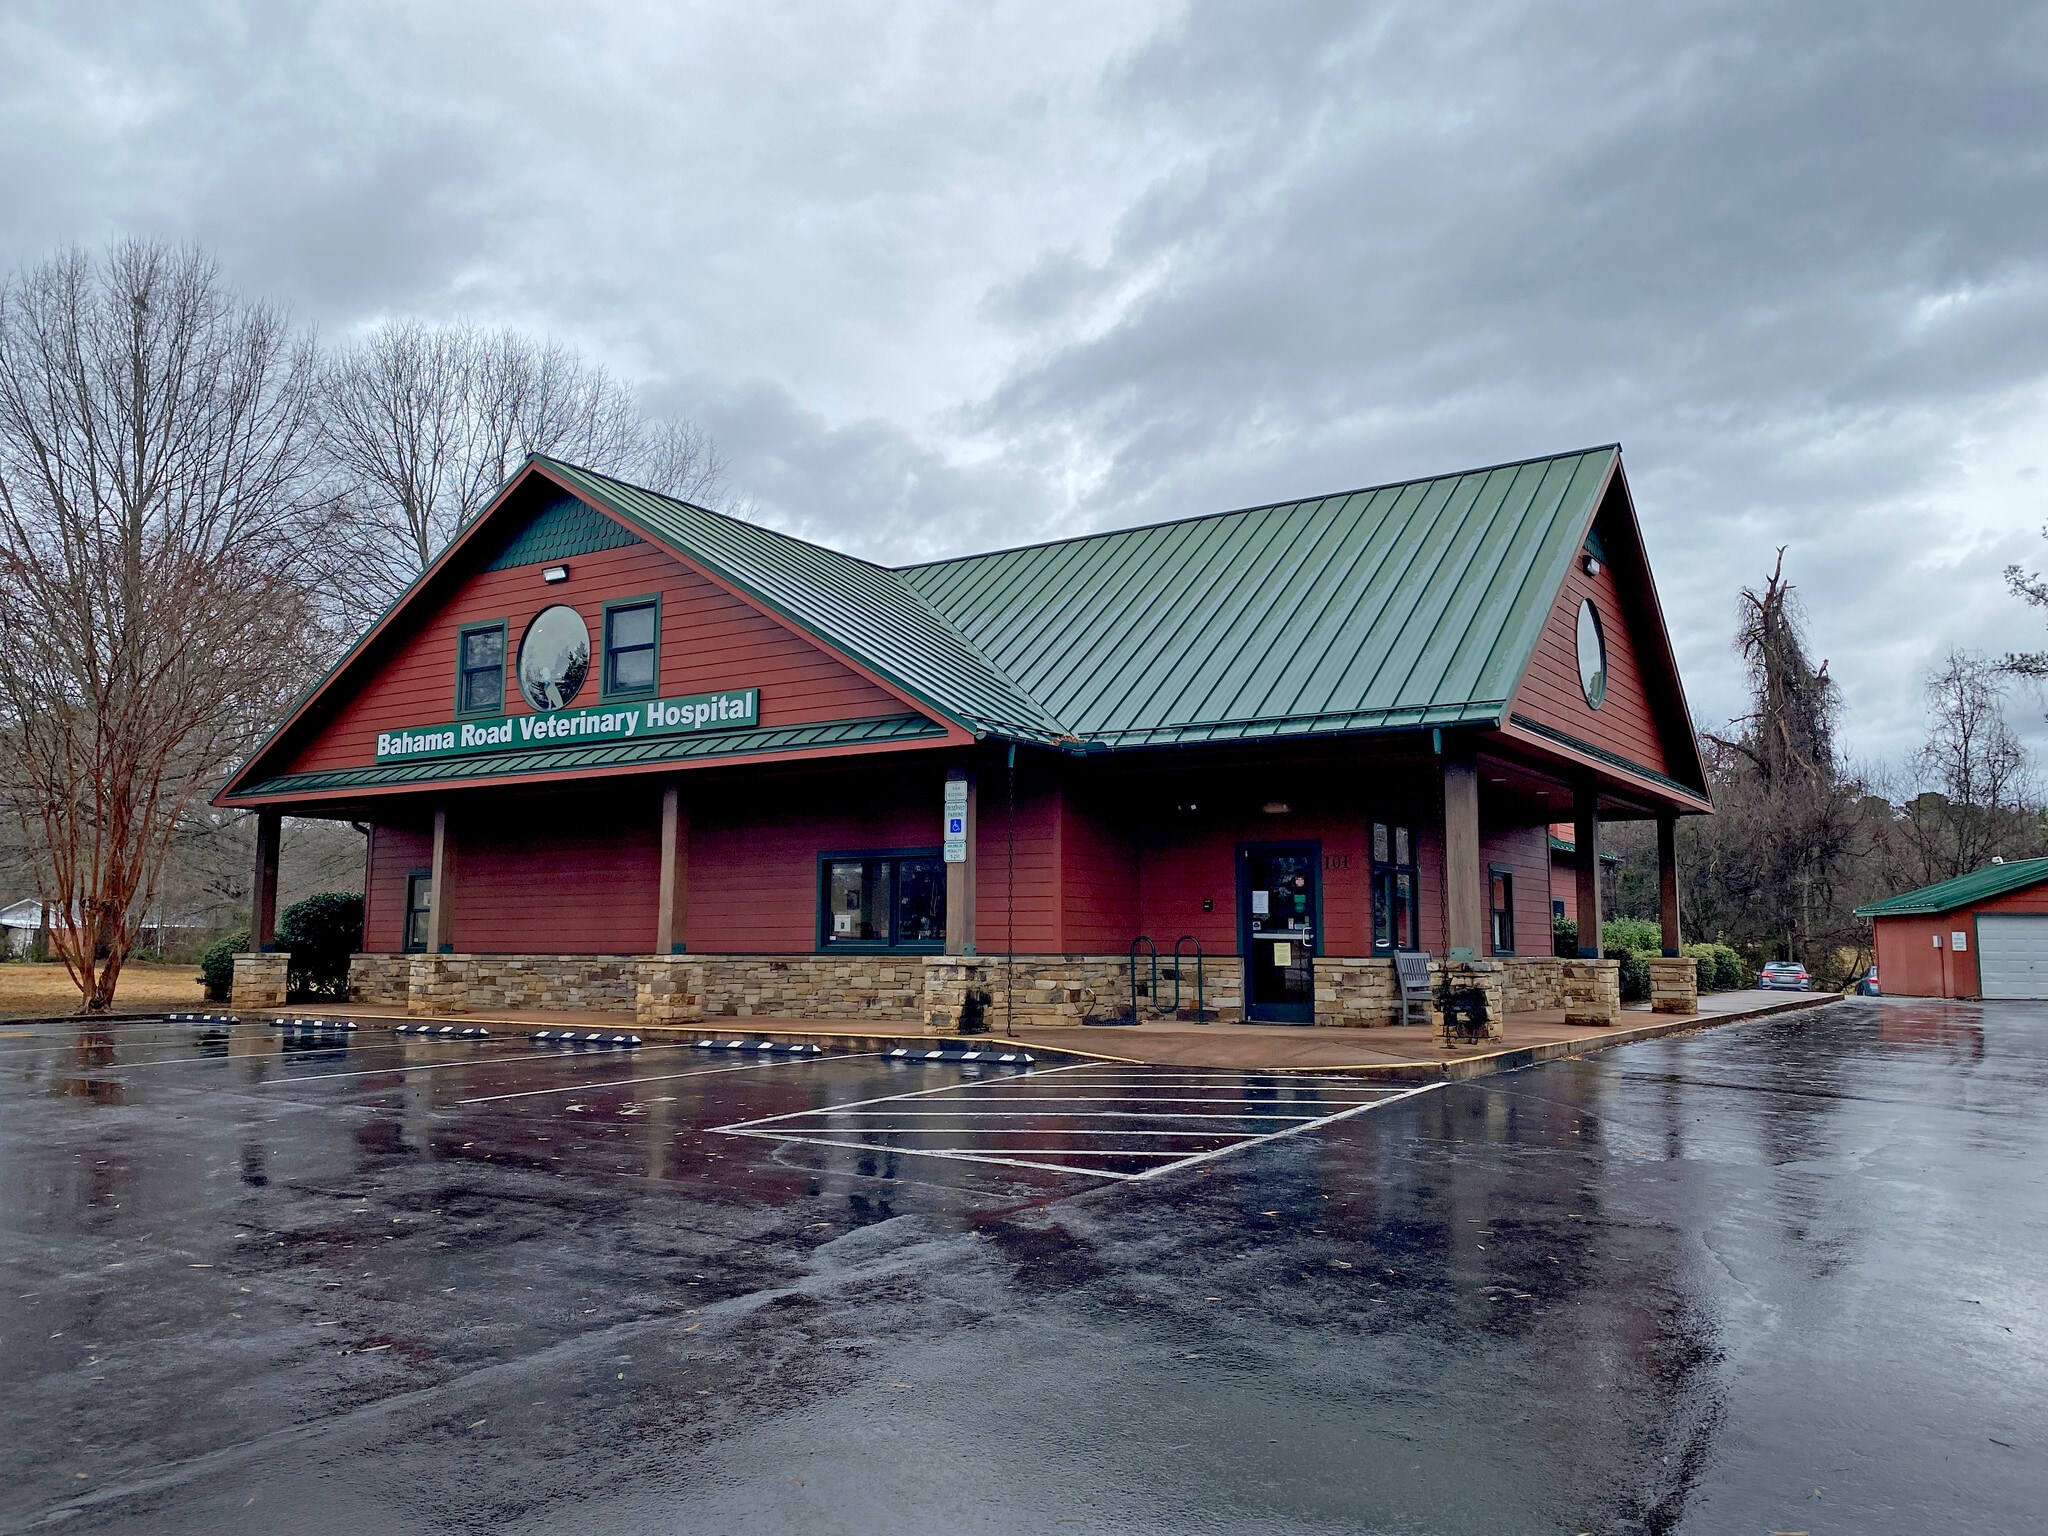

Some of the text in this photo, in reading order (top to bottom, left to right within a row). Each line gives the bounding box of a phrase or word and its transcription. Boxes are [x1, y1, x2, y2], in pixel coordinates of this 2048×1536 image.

[377, 692, 753, 756] Bahama Road Veterinary Hospital
[1323, 856, 1349, 870] 101
